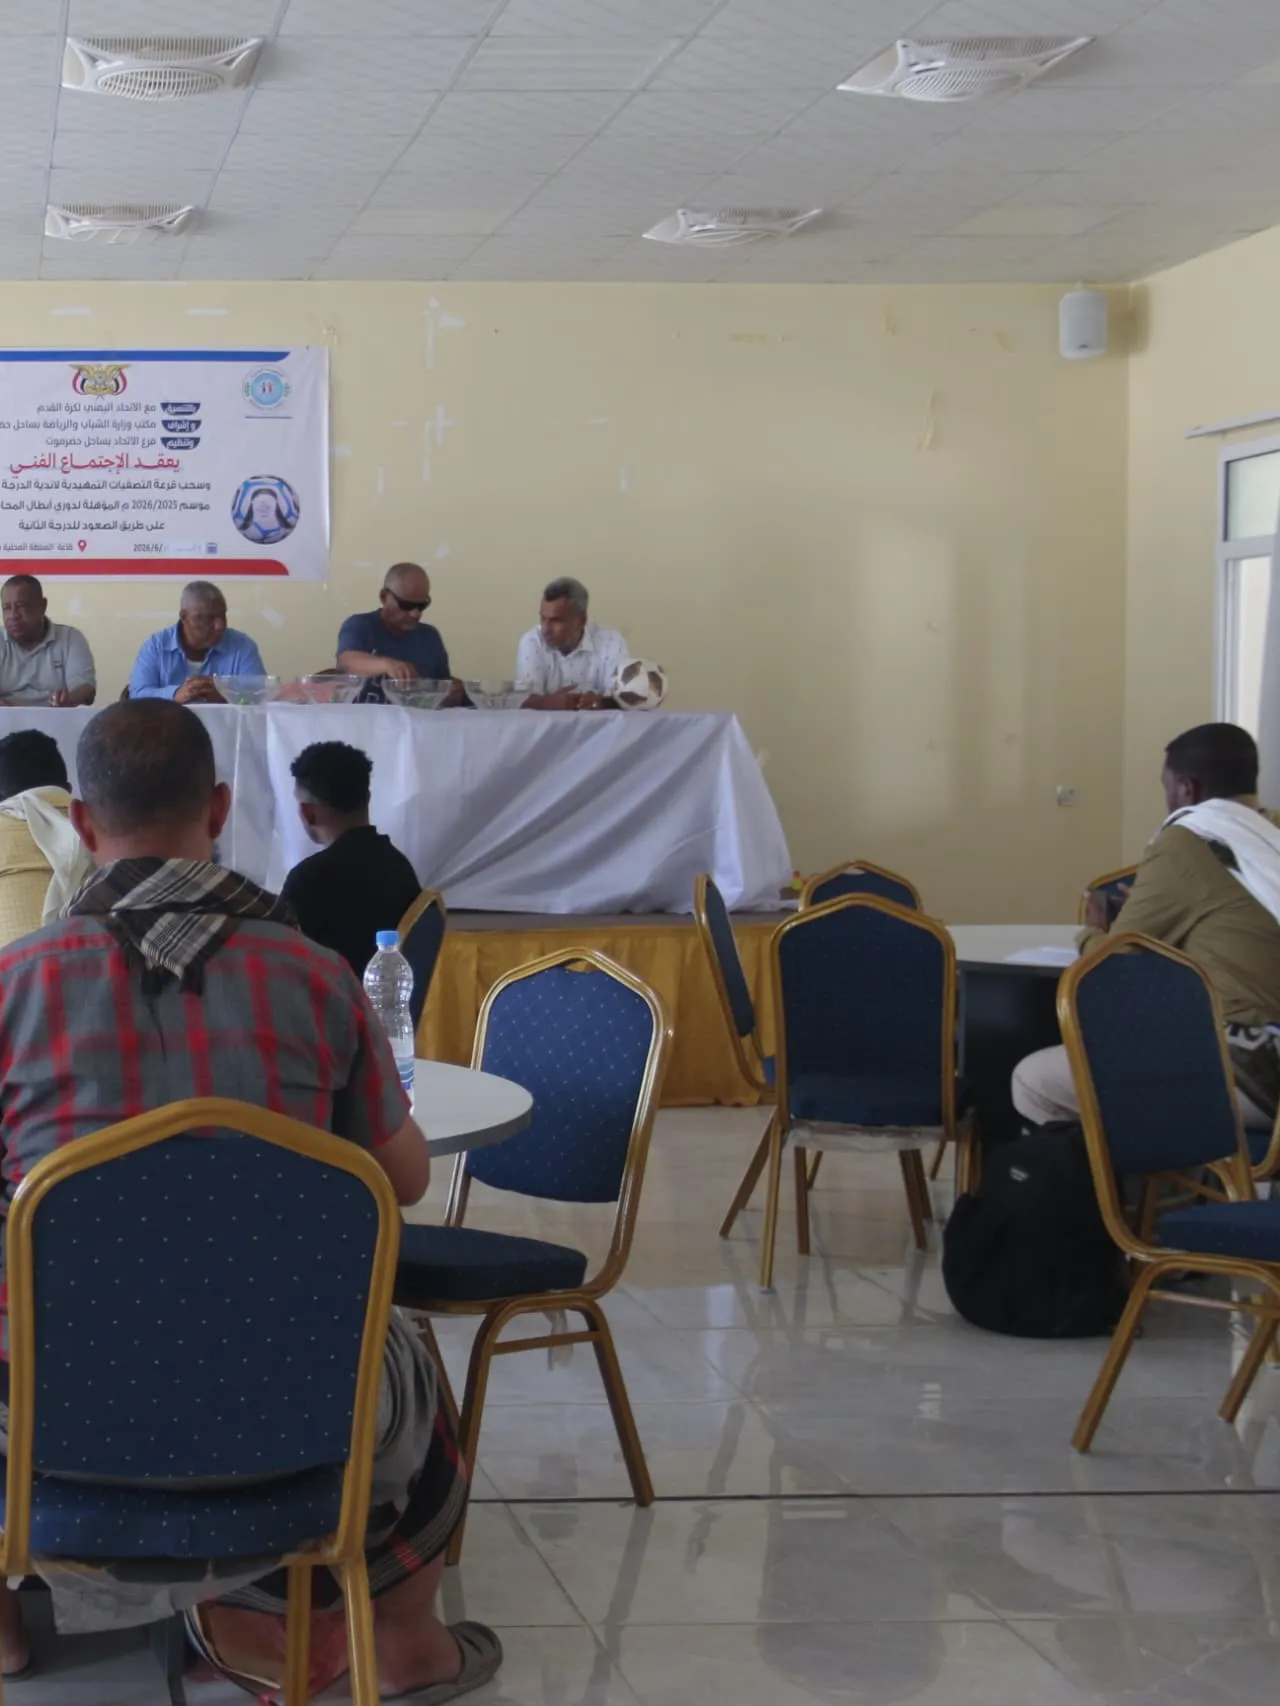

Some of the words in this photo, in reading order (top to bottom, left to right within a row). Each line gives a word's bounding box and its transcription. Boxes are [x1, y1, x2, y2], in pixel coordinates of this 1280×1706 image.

[37, 402, 62, 414] القدم
[64, 402, 81, 414] لكرة
[83, 402, 113, 414] اليمني
[116, 402, 142, 412] الاتحاد
[144, 404, 157, 415] مع
[13, 419, 41, 431] بساحل
[42, 419, 79, 431] والرياضة
[80, 419, 110, 431] الشباب
[111, 419, 132, 431] وزارة
[133, 420, 157, 429] مكتب
[45, 437, 82, 448] حضرموت
[84, 436, 112, 448] بساحل
[114, 436, 140, 446] الاتحاد
[141, 437, 157, 448] فرع
[2, 480, 32, 491] الدرجة
[61, 479, 107, 491] التمهيدية
[108, 480, 152, 490] التصفيات
[153, 479, 177, 491] قرعة
[178, 481, 211, 491] وسحب
[54, 500, 81, 512] لدوري
[82, 499, 120, 511] المؤهلة
[121, 502, 130, 511] م
[179, 502, 211, 511] موسم
[18, 519, 47, 530] الثانية
[48, 520, 80, 531] للدرجة
[81, 520, 118, 531] الصعود
[120, 520, 144, 531] طريق
[145, 521, 165, 531] على
